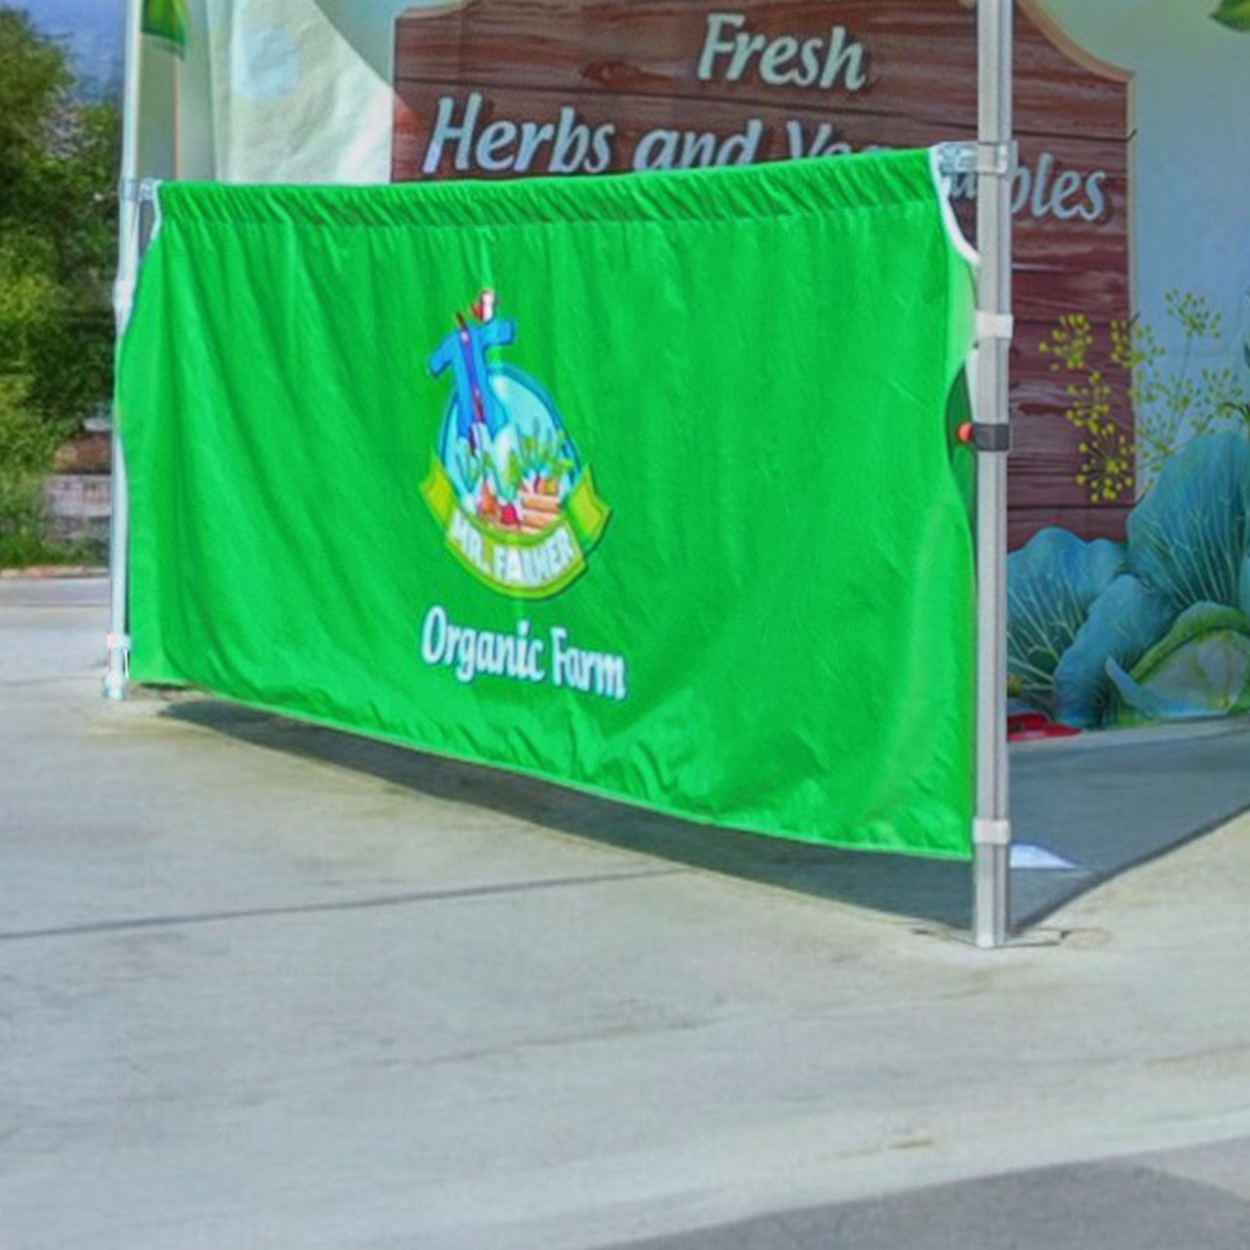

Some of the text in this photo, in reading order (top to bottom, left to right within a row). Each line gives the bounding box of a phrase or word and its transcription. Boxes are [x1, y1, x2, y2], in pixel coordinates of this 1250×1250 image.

[697, 12, 867, 92] Fresh
[422, 91, 616, 174] Herbs
[632, 118, 764, 172] and
[422, 605, 626, 701] Organic Farm
